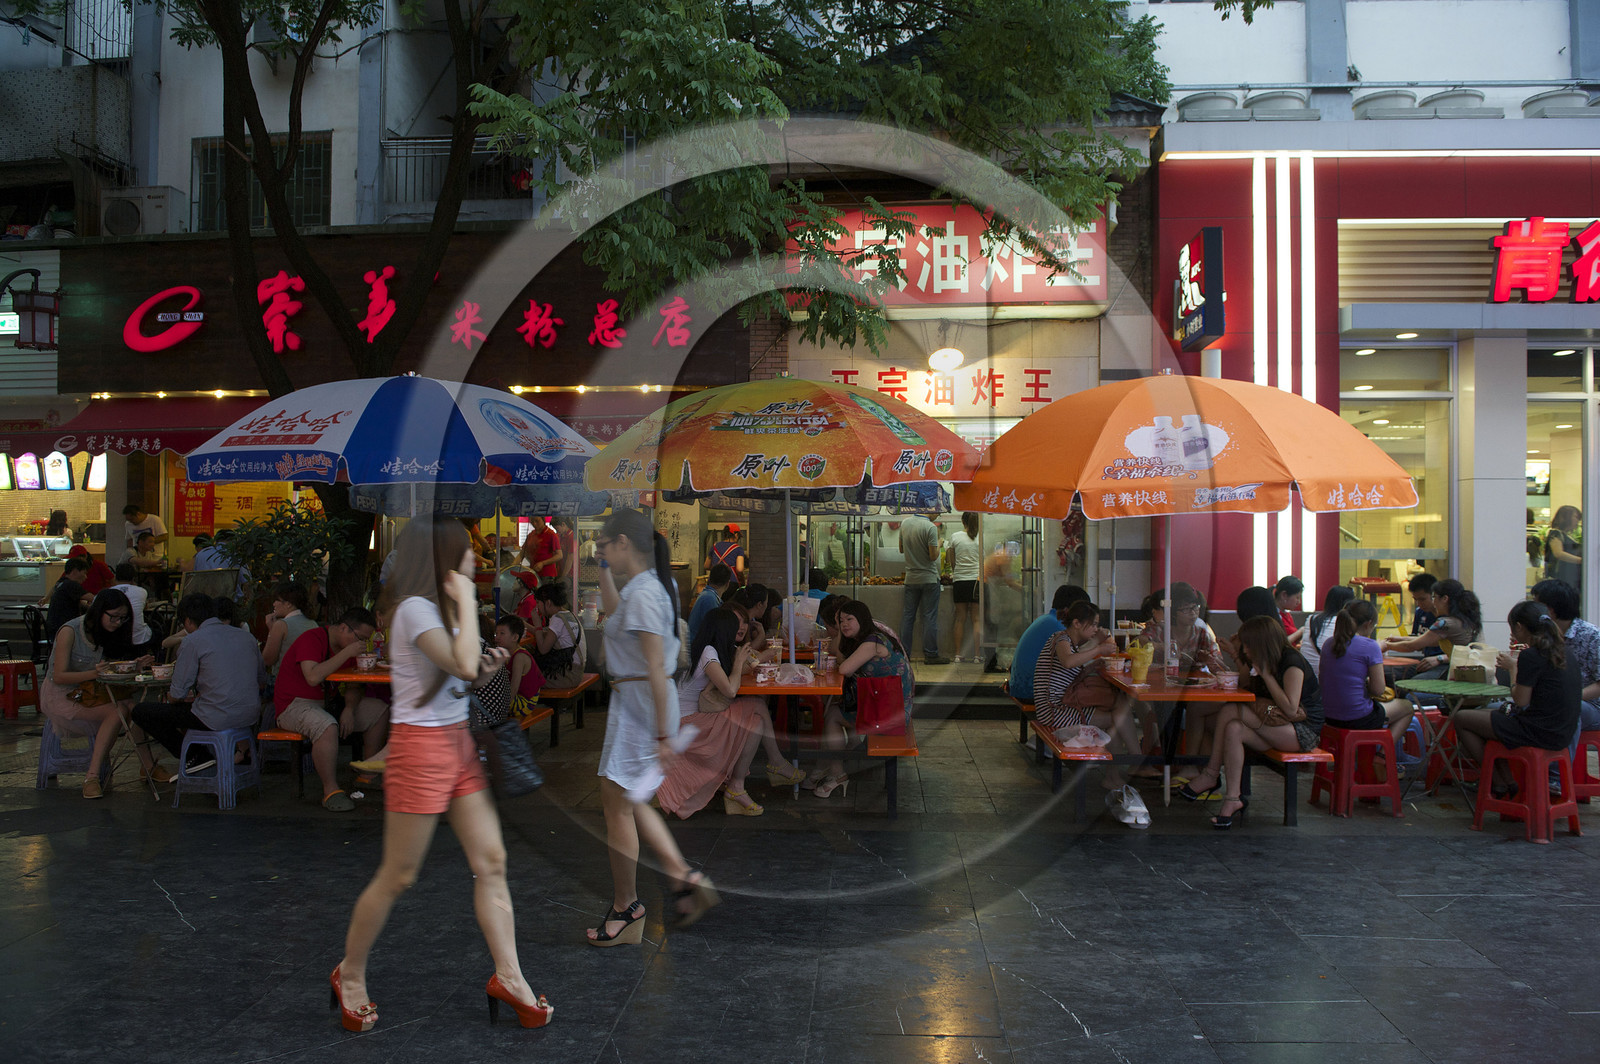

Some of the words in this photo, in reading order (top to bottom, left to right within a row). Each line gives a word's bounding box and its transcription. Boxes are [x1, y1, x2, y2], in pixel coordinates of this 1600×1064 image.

[796, 220, 1101, 294] 宗油炸王
[238, 409, 345, 434] 娃哈哈
[198, 458, 239, 477] 娃哈哈
[380, 456, 443, 477] 娃哈哈
[515, 464, 552, 482] 娃哈哈
[609, 458, 643, 484] 原叶
[730, 453, 791, 482] 原叶
[892, 450, 931, 477] 原叶
[865, 488, 920, 504] 百事可乐
[982, 486, 1039, 512] 娃哈哈
[1101, 489, 1168, 508] 营养快线
[1327, 483, 1384, 508] 娃哈哈
[521, 501, 581, 516] PEPSI
